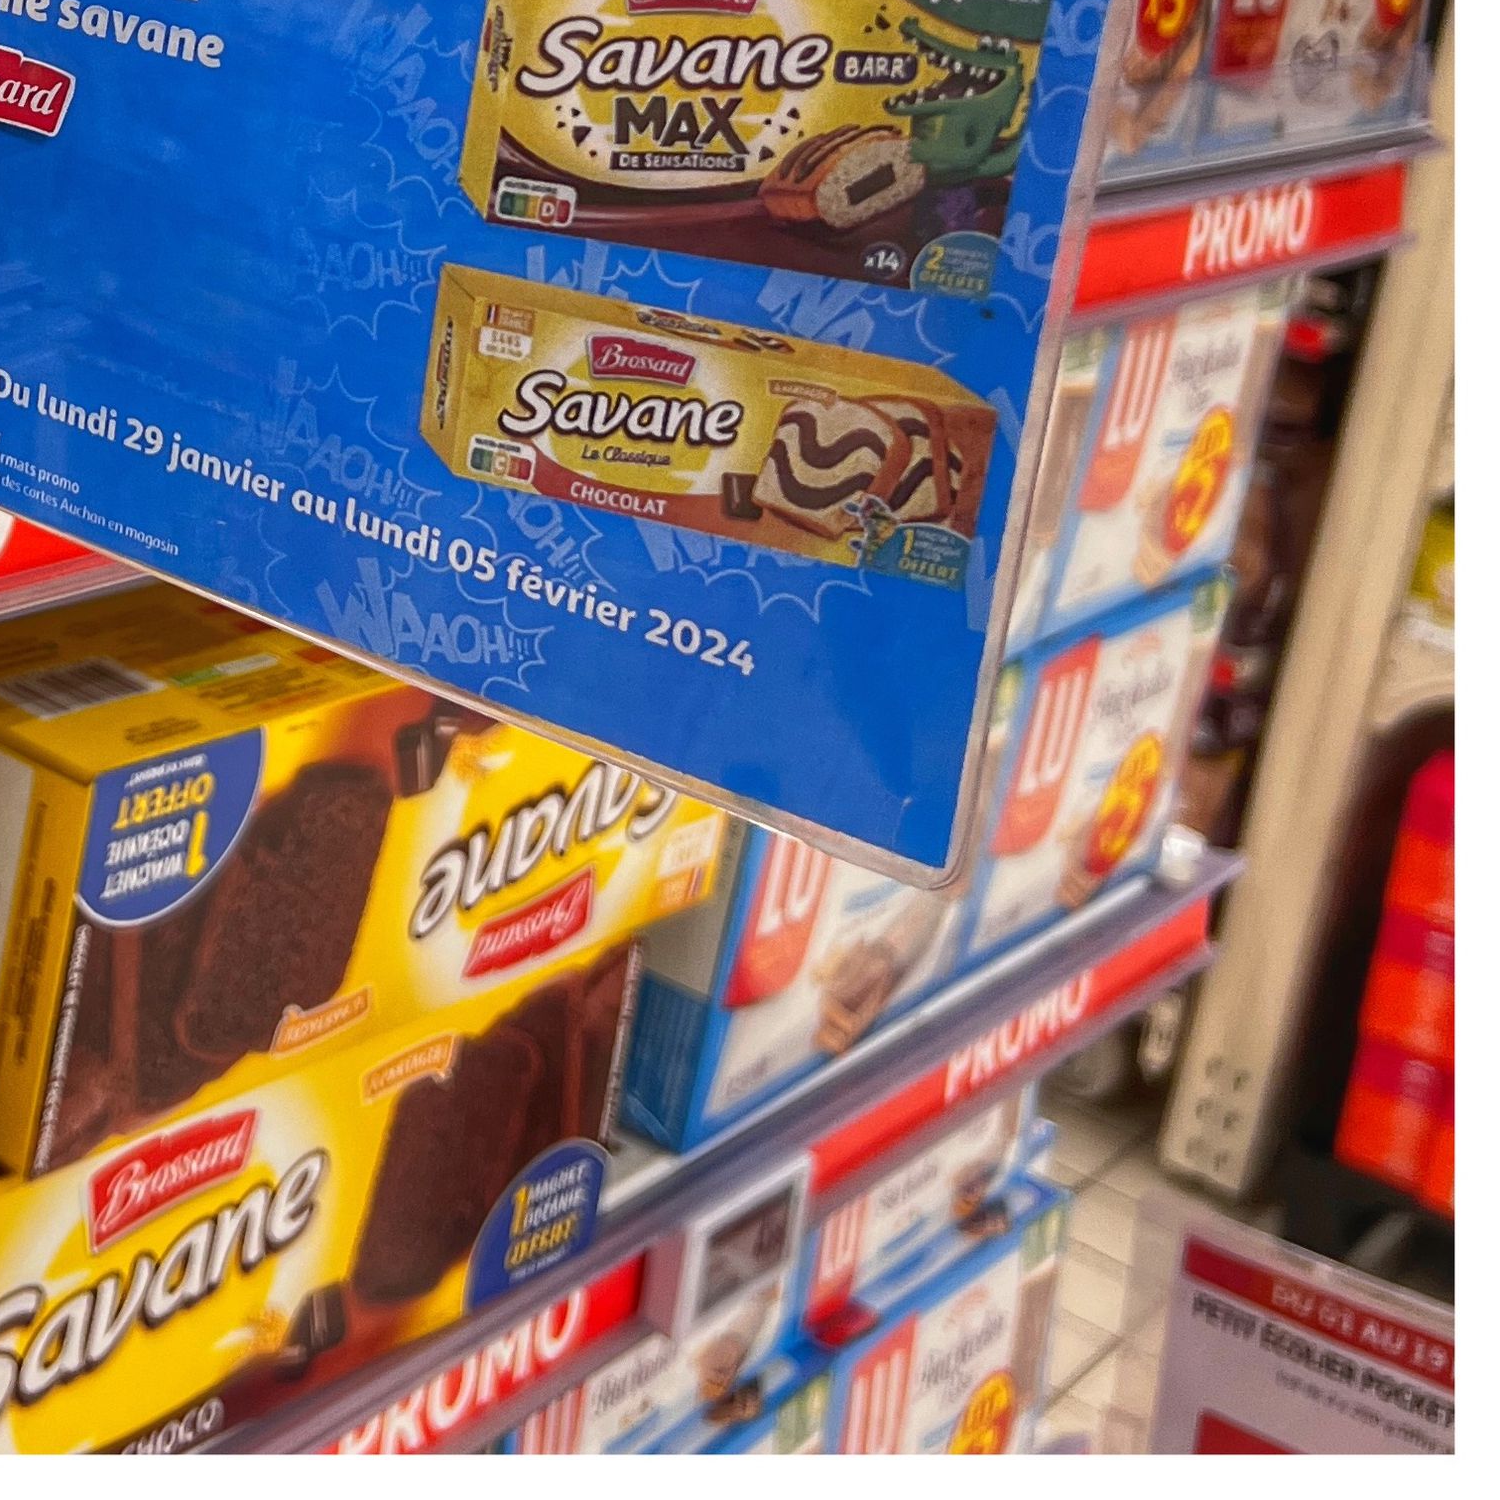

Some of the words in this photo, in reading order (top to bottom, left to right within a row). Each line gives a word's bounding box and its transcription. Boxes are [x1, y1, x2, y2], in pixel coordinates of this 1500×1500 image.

[515, 15, 832, 100] Savane
[613, 95, 750, 155] MAX
[618, 153, 639, 168] DE
[644, 154, 737, 169] SENSATIONS
[1183, 185, 1316, 282] PROMO
[595, 343, 690, 379] Brossard
[498, 368, 744, 449] Savane
[1, 470, 22, 493] des
[23, 483, 58, 510] cartes
[59, 495, 106, 528] Auchan
[108, 517, 123, 535] en
[125, 524, 180, 557] magasin
[37, 467, 80, 495] promo
[569, 480, 667, 516] CHOCOLAT
[37, 382, 117, 441] lundi
[122, 417, 164, 456] 29
[165, 432, 286, 503] janvier
[290, 486, 337, 525] au
[344, 497, 440, 562] lundi
[447, 538, 498, 583] 05
[506, 558, 637, 632] février
[644, 608, 755, 678] 2024
[101, 1115, 250, 1233] Brossard
